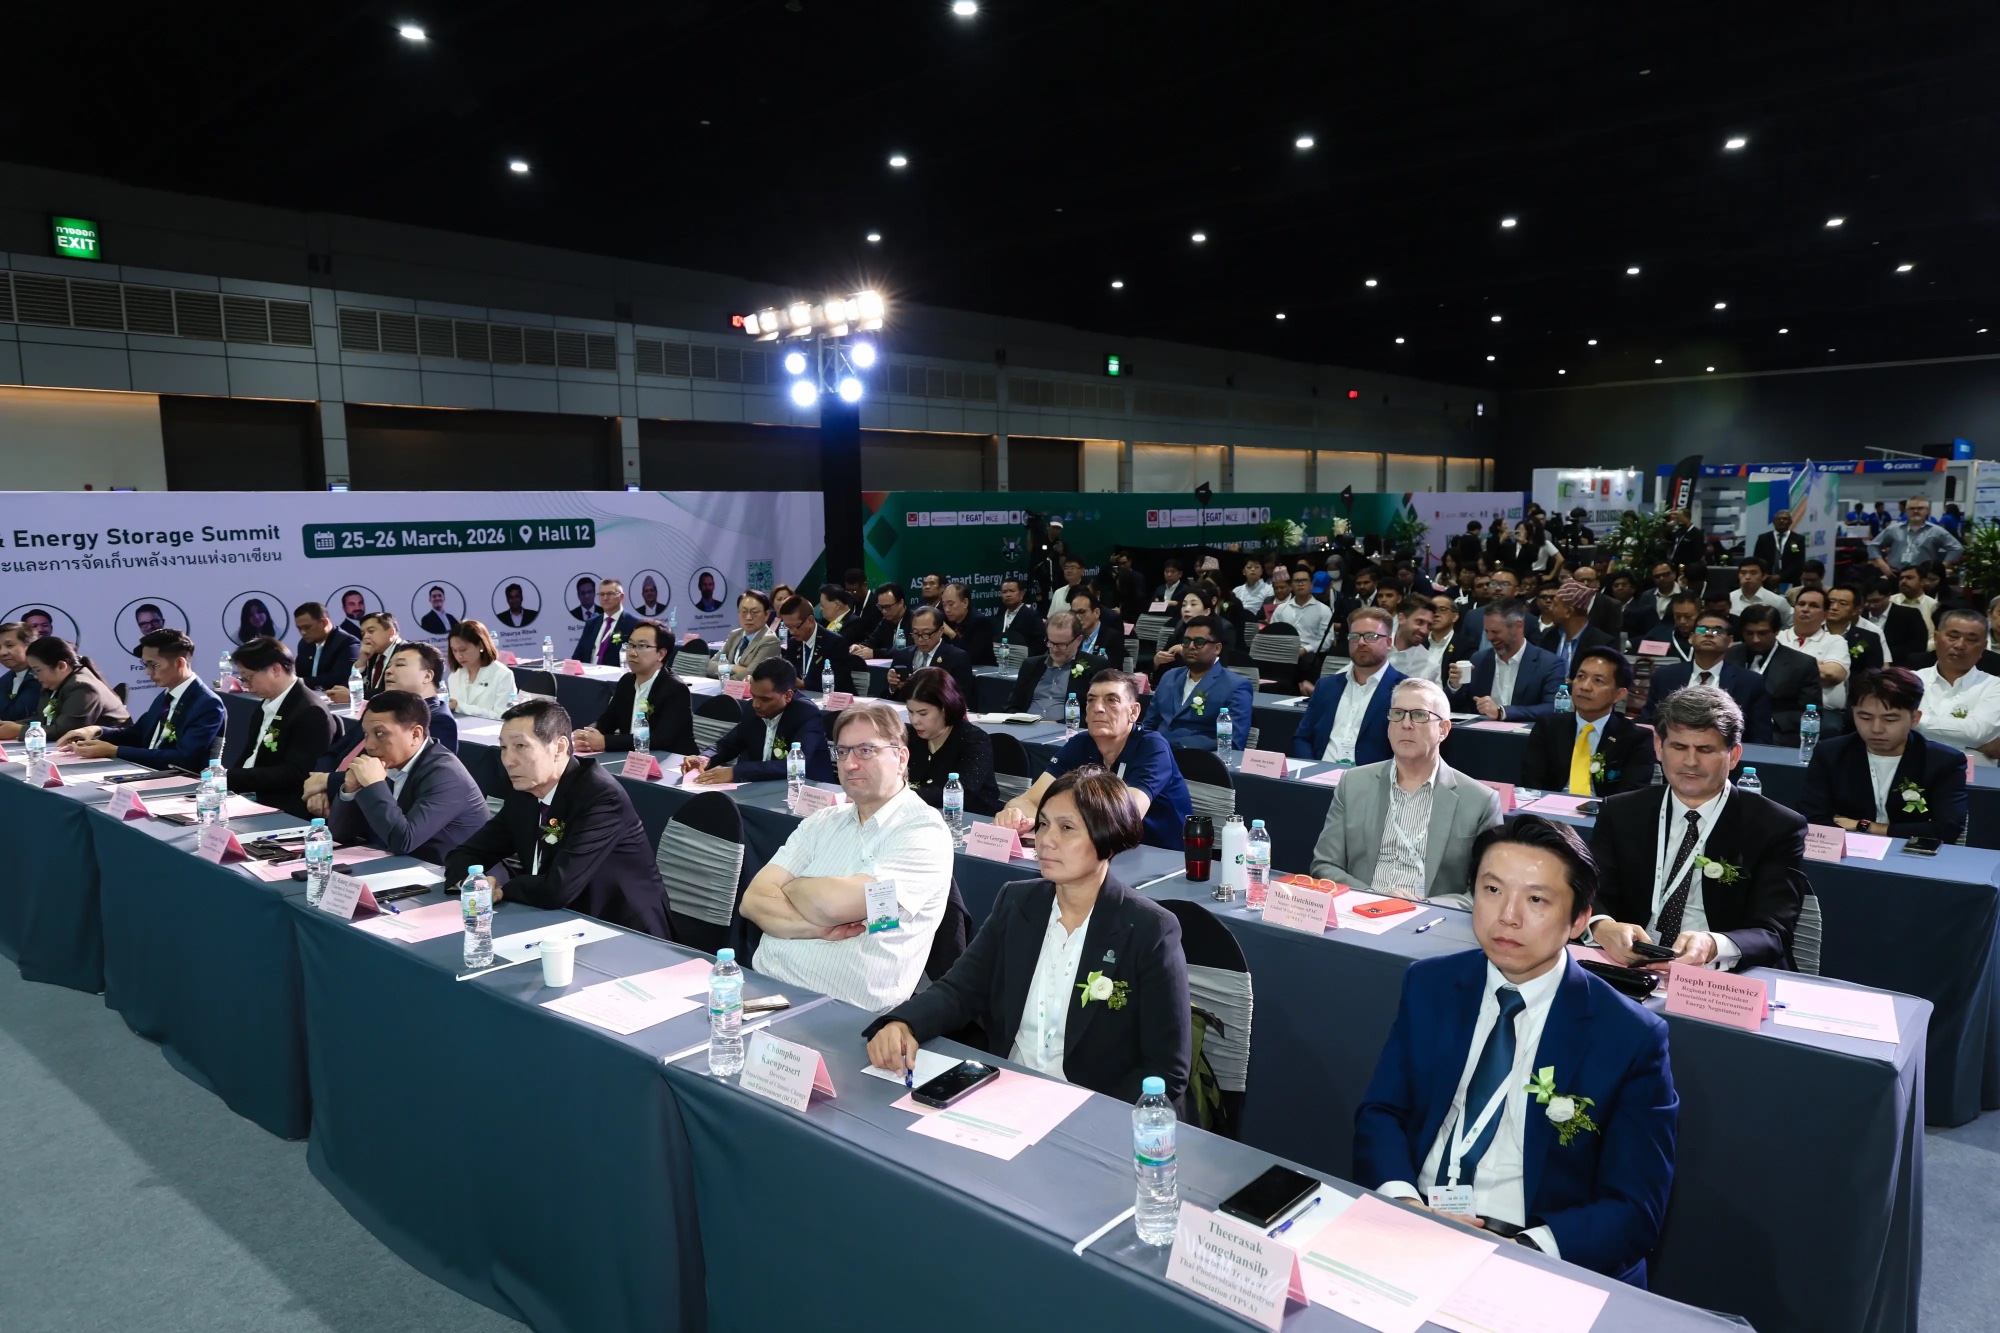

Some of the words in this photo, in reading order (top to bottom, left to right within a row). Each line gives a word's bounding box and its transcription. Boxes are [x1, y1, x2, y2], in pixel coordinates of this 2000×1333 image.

[57, 235, 96, 250] EXIT
[14, 528, 98, 550] Energy
[107, 526, 194, 548] Storage
[202, 525, 280, 542] Summit
[341, 532, 396, 550] 25-26
[402, 530, 463, 548] March,
[467, 528, 506, 546] 2026
[538, 526, 570, 542] Hall
[575, 526, 590, 541] 12
[974, 573, 1003, 585] Energy
[975, 832, 989, 840] George
[1274, 891, 1290, 900] Mark
[1292, 896, 1324, 909] Hutchinson
[1675, 974, 1704, 986] Joseph
[1707, 981, 1759, 997] Tomkiewicz
[1682, 986, 1707, 995] Regional
[1722, 994, 1748, 1003] President
[1676, 992, 1707, 1002] Association
[1715, 1000, 1754, 1012] International
[1685, 1000, 1706, 1009] Energy
[1708, 1005, 1741, 1016] Negotiators
[766, 1042, 801, 1062] Chomphoo
[761, 1054, 801, 1077] Kaewprasert
[745, 1070, 769, 1084] Department
[1209, 1220, 1263, 1255] Theerasak
[1197, 1234, 1268, 1277] Vongchansilp
[1179, 1257, 1194, 1270] Thai
[1196, 1265, 1238, 1290] Photovoltaic
[1240, 1285, 1275, 1308] Industries
[1190, 1275, 1228, 1299] Association
[1229, 1294, 1258, 1314] (TPVA)
